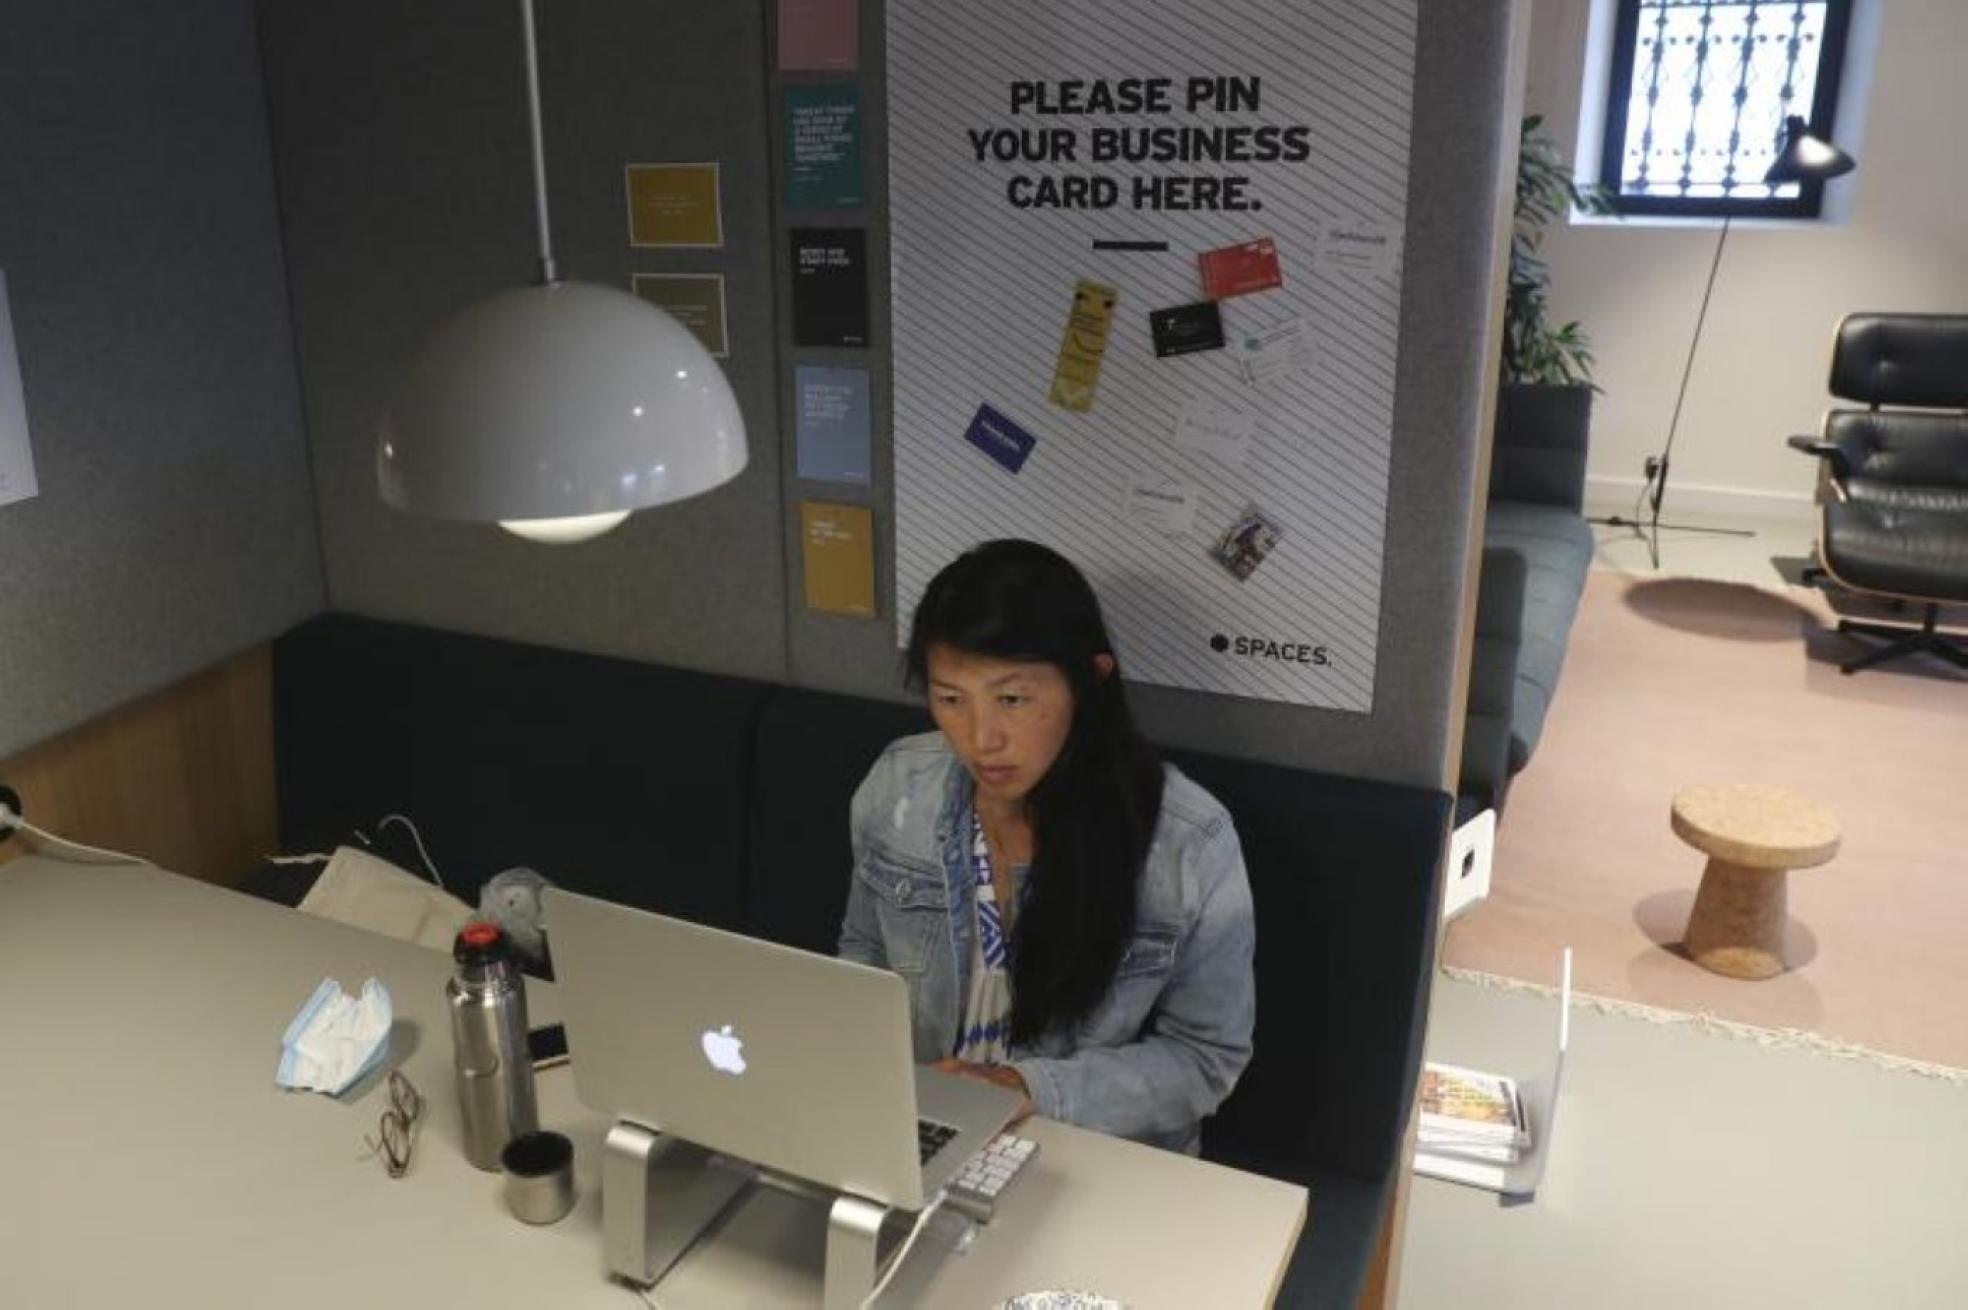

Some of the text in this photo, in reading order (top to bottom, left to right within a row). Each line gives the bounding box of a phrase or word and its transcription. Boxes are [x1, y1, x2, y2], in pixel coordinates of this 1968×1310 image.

[1010, 76, 1261, 115] PLEASE PIN
[968, 126, 1311, 162] YOUR BUSINESS
[1007, 175, 1263, 211] CARD HERE.
